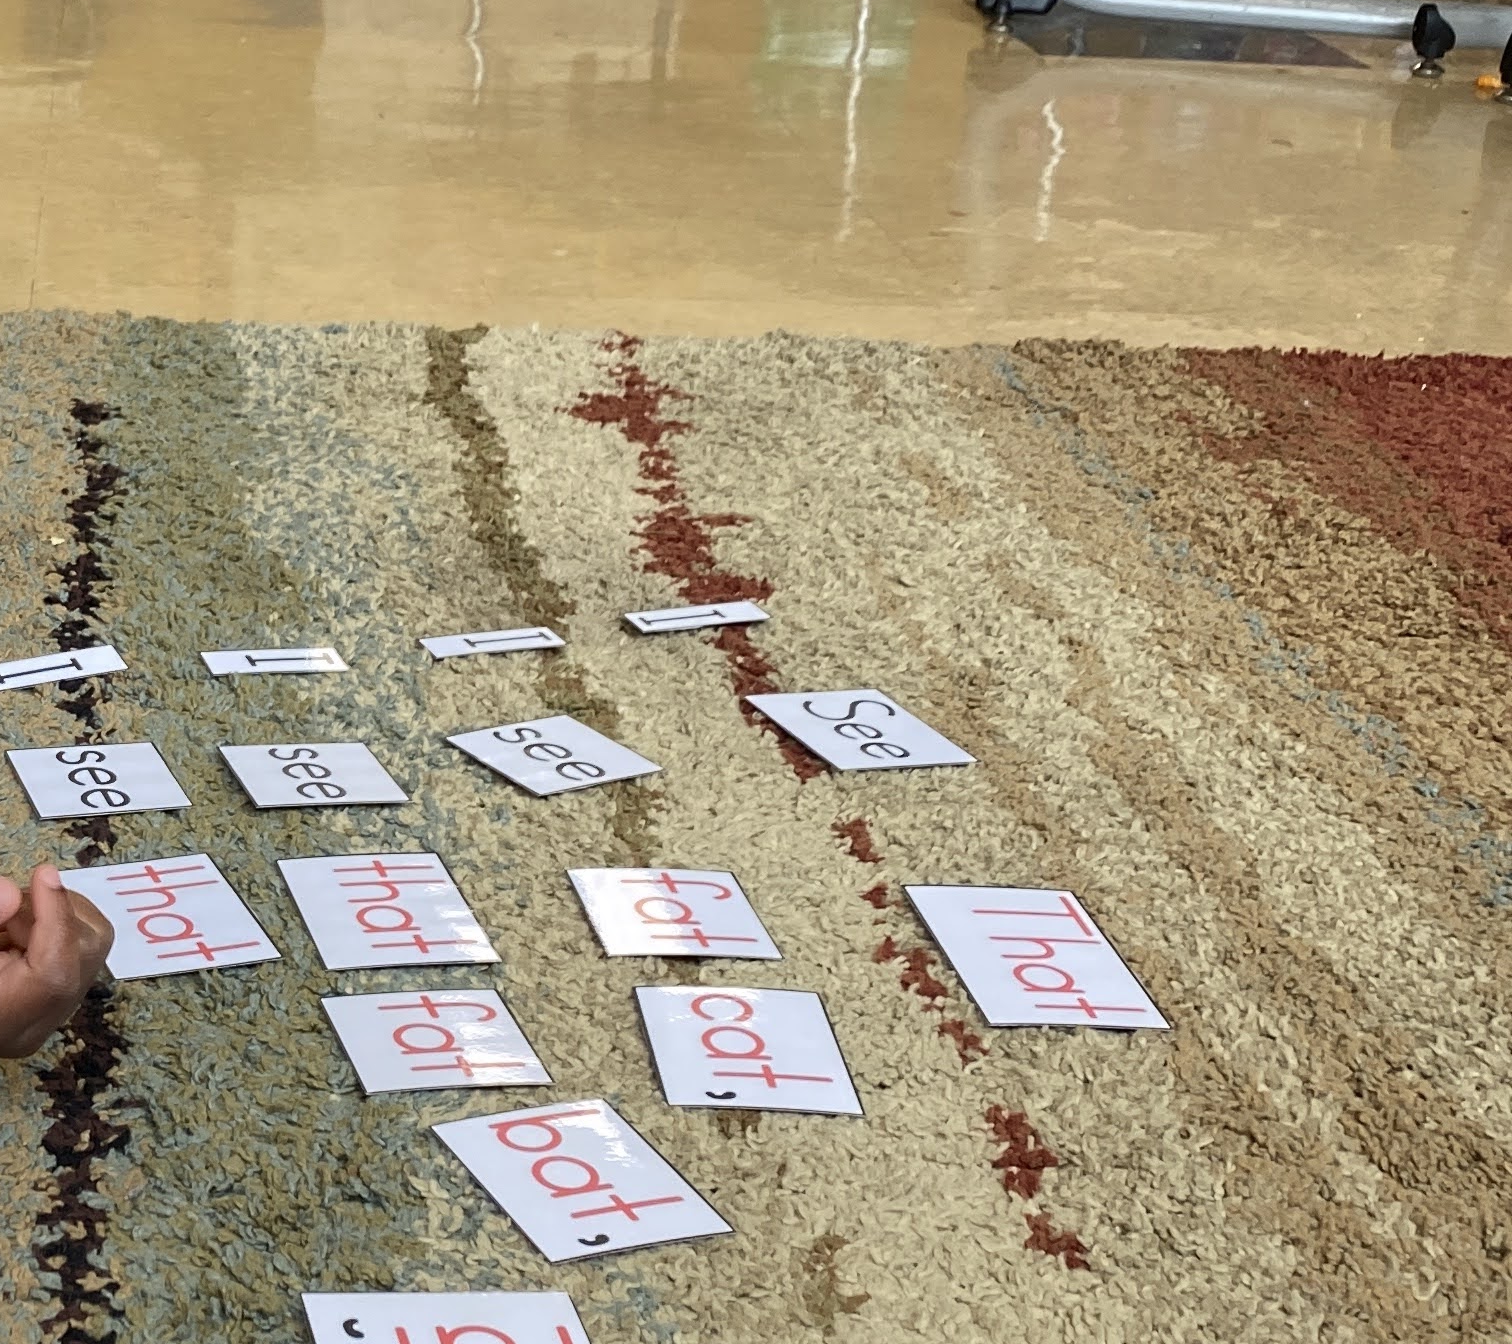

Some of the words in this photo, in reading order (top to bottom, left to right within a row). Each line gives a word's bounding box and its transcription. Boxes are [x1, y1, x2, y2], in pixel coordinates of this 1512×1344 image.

[244, 654, 335, 667] I
[463, 631, 553, 648] I
[492, 724, 607, 784] see
[803, 698, 912, 760] See
[54, 748, 132, 810] see
[267, 745, 348, 802] see
[107, 864, 261, 962] that
[334, 859, 479, 956] that
[621, 871, 759, 949] fat
[971, 895, 1147, 1019] That
[378, 993, 526, 1079] fat
[690, 992, 835, 1101] cat,
[488, 1108, 685, 1247] bat,
